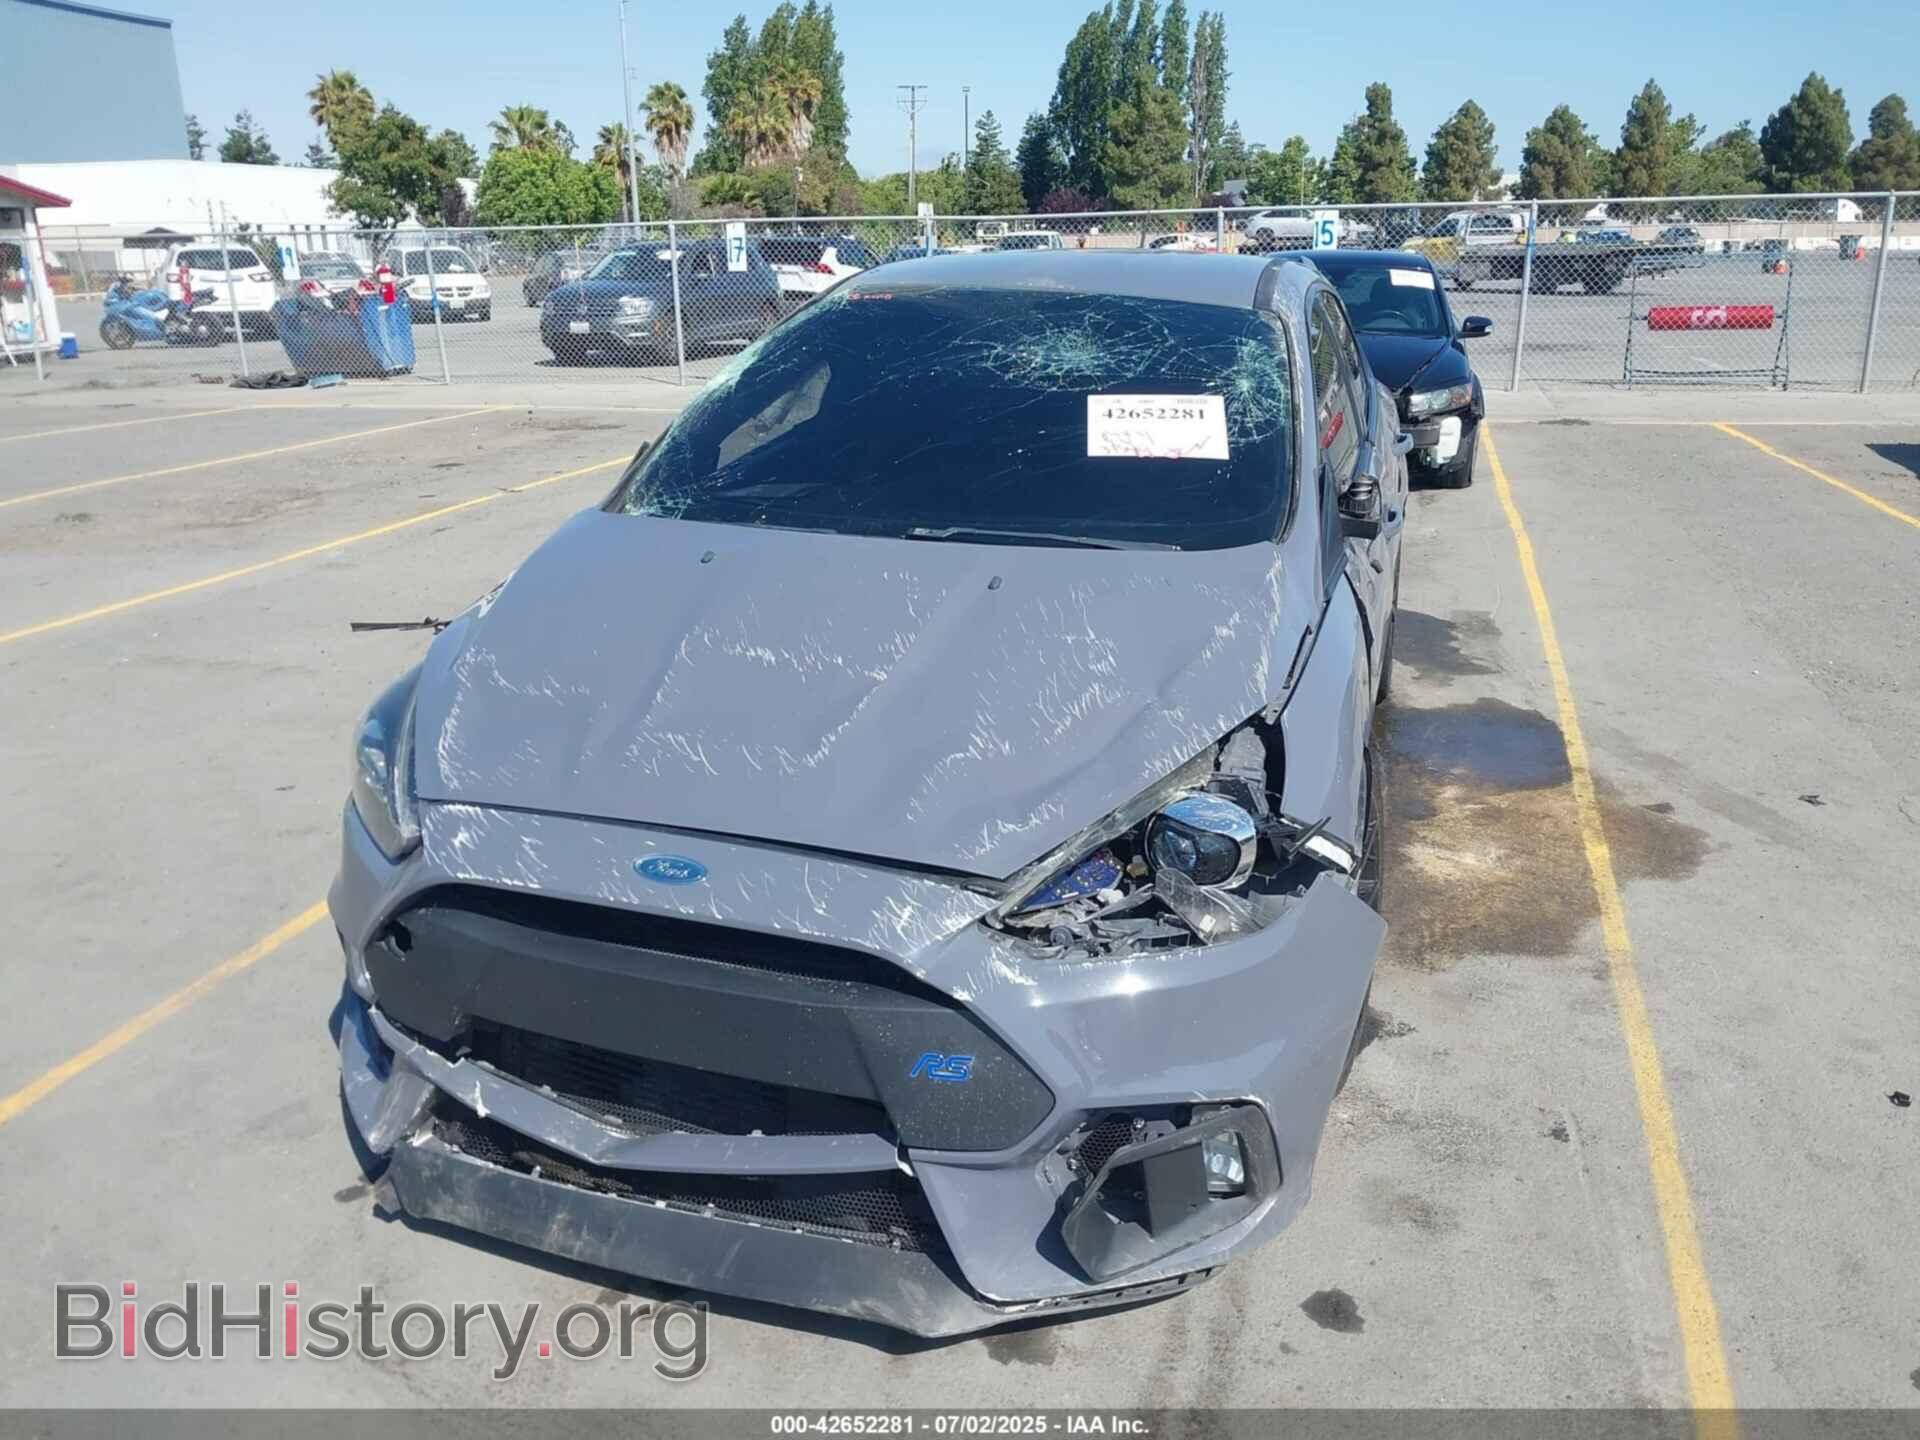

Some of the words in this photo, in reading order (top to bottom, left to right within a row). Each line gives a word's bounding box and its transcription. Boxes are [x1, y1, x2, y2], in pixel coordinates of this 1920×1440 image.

[1315, 220, 1334, 248] 15
[729, 237, 744, 263] 17
[1102, 408, 1206, 420] 42652281
[646, 860, 690, 879] Ford
[911, 1052, 976, 1081] RS
